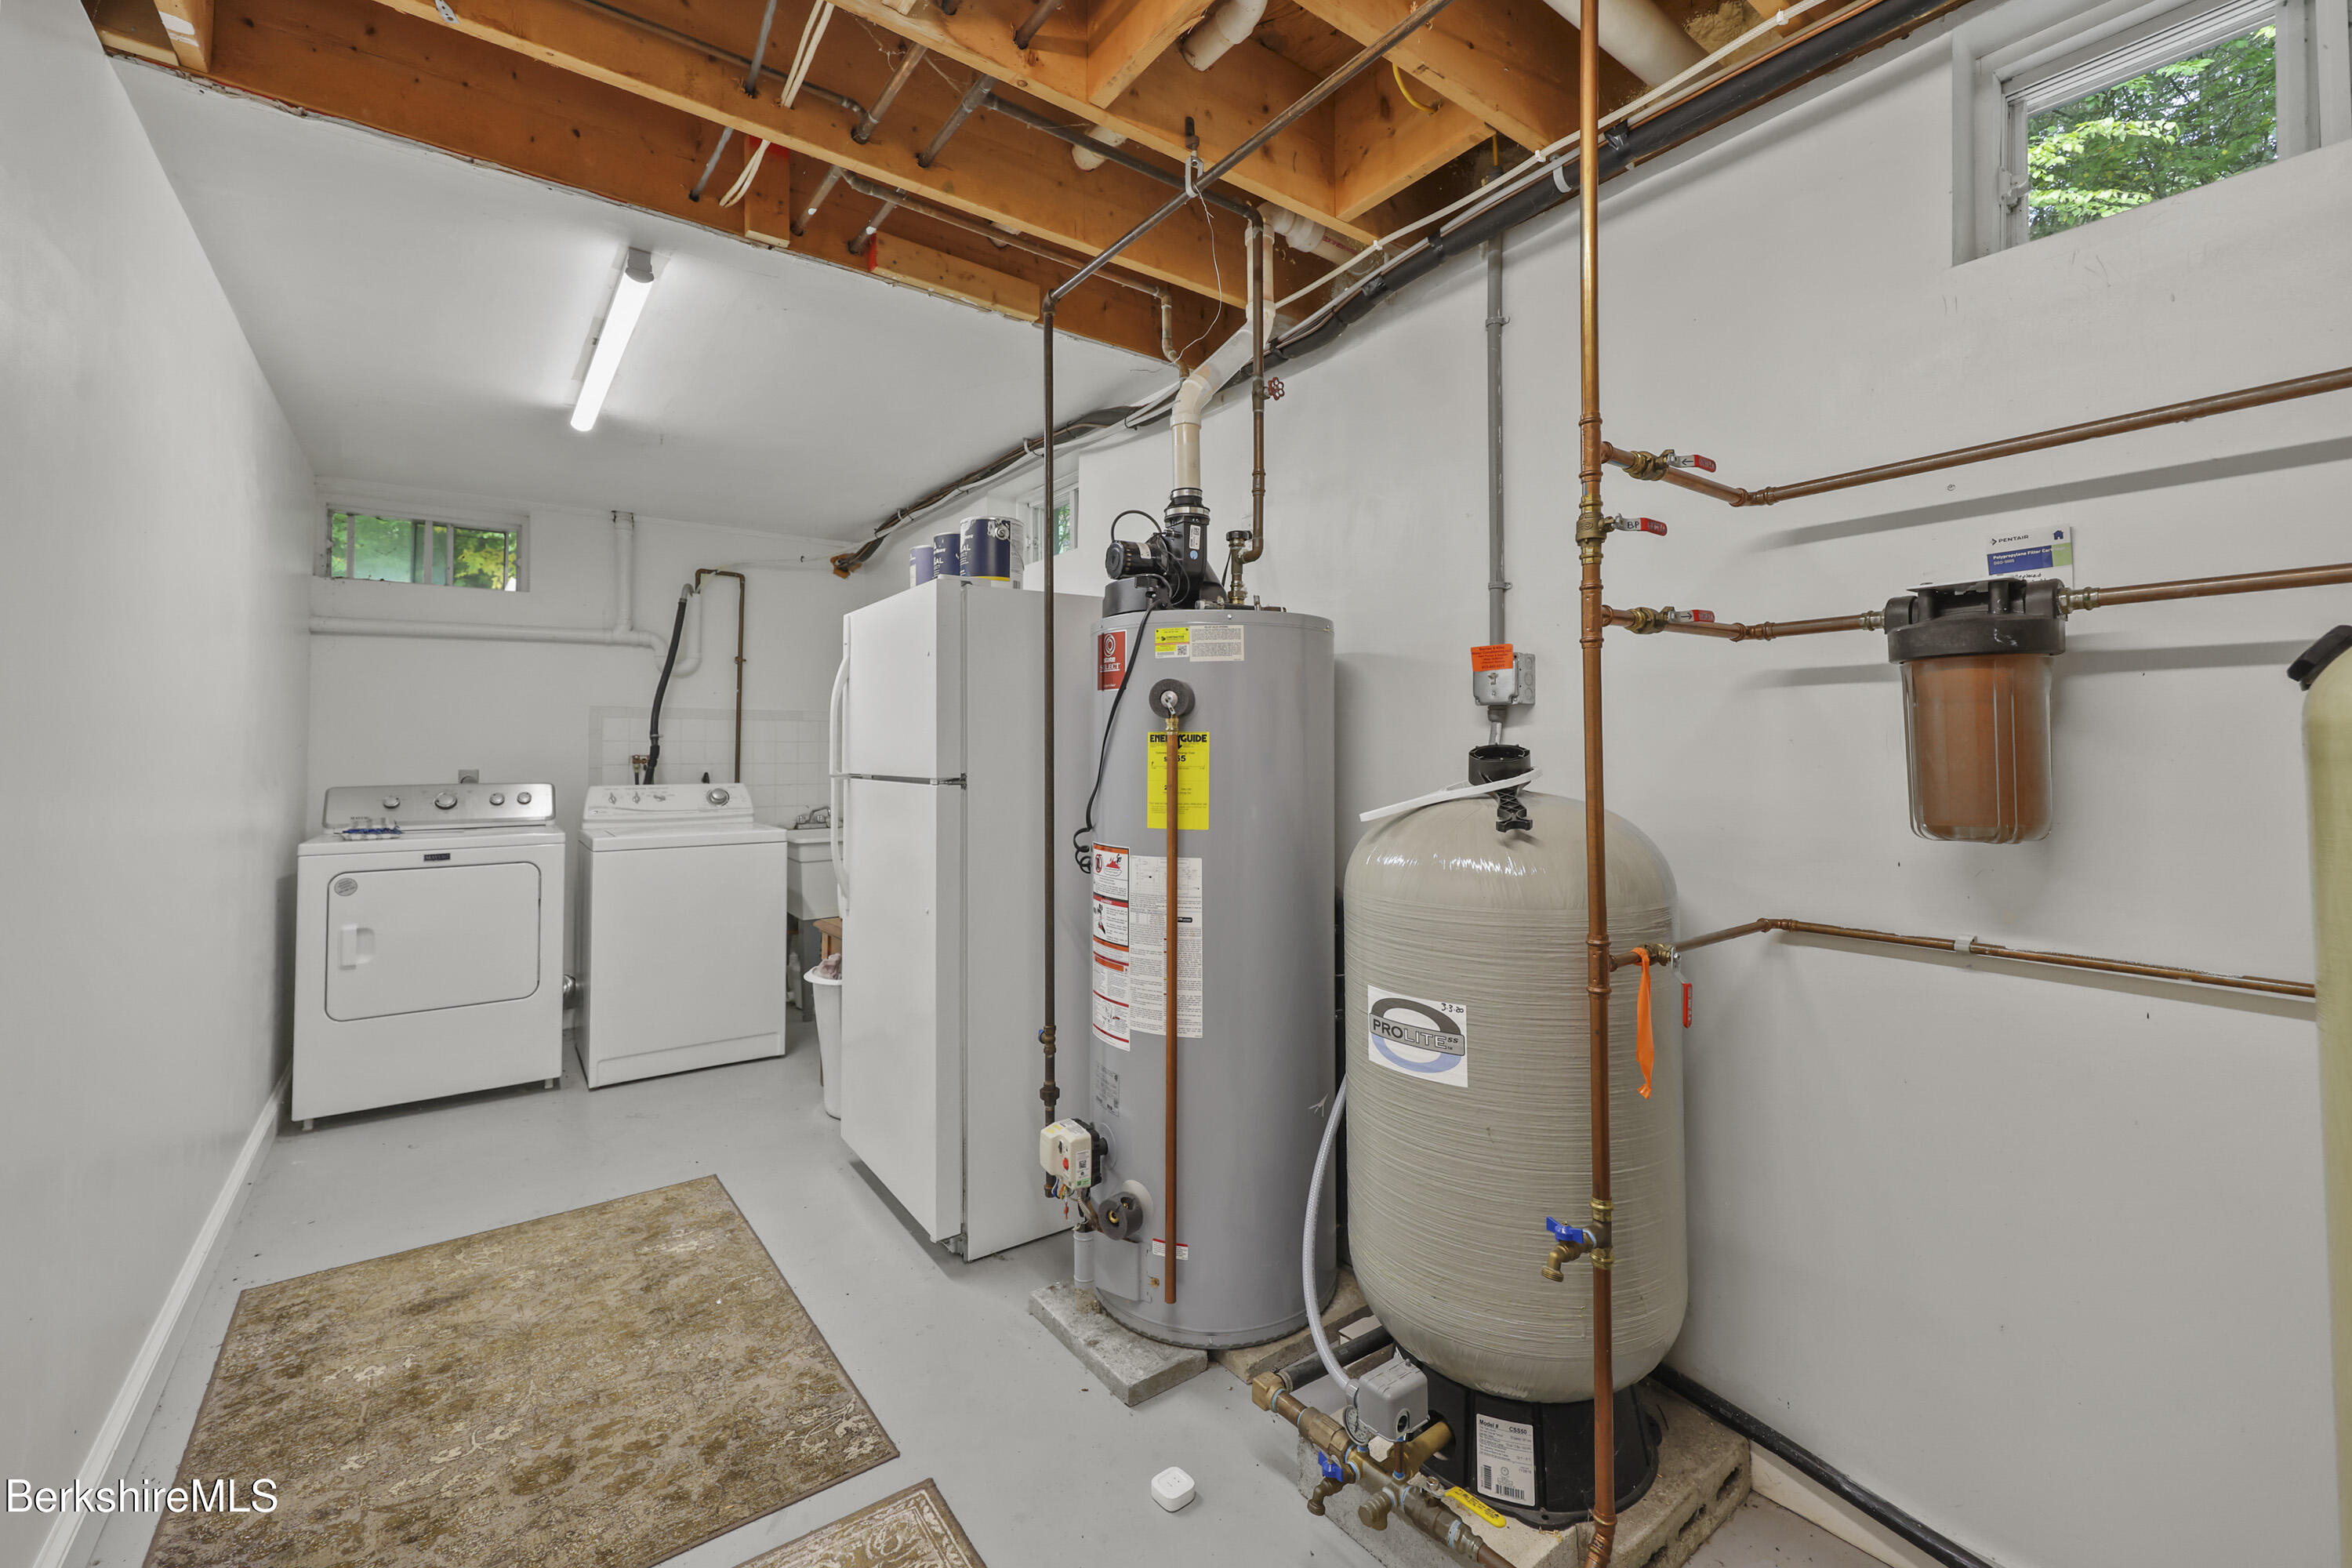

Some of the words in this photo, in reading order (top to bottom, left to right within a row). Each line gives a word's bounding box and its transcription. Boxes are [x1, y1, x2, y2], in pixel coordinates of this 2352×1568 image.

[1627, 521, 1639, 529] BP
[1373, 1018, 1447, 1050] PROLITE
[1479, 1419, 1494, 1428] Model
[1508, 1426, 1527, 1435] CSS50
